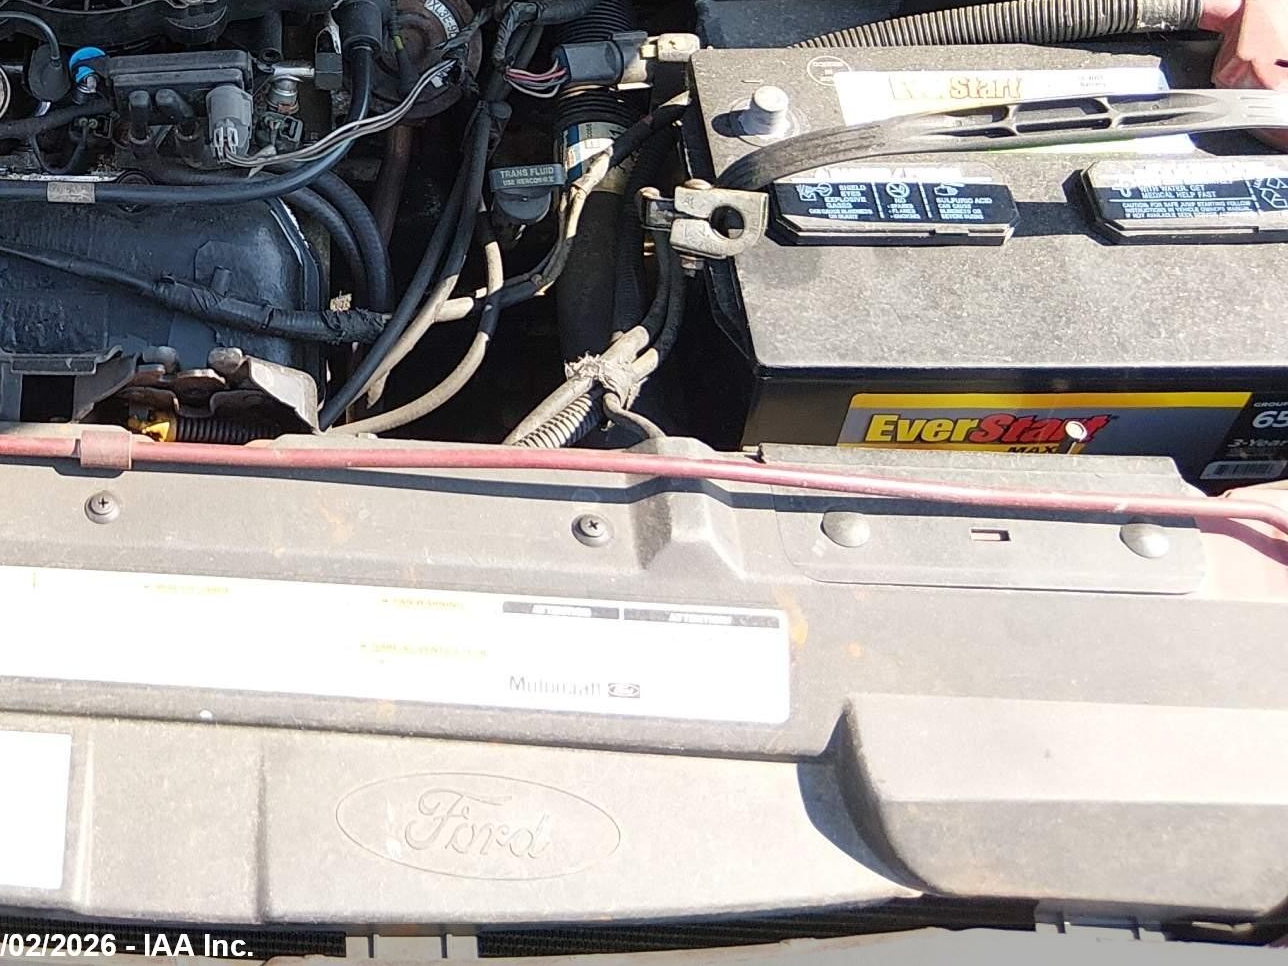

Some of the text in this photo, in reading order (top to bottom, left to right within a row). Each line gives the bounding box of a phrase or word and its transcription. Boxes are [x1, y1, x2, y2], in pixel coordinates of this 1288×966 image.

[499, 167, 554, 179] TRANS FLUID
[1189, 184, 1205, 192] GET
[1252, 410, 1288, 429] 65
[404, 788, 551, 859] Ford
